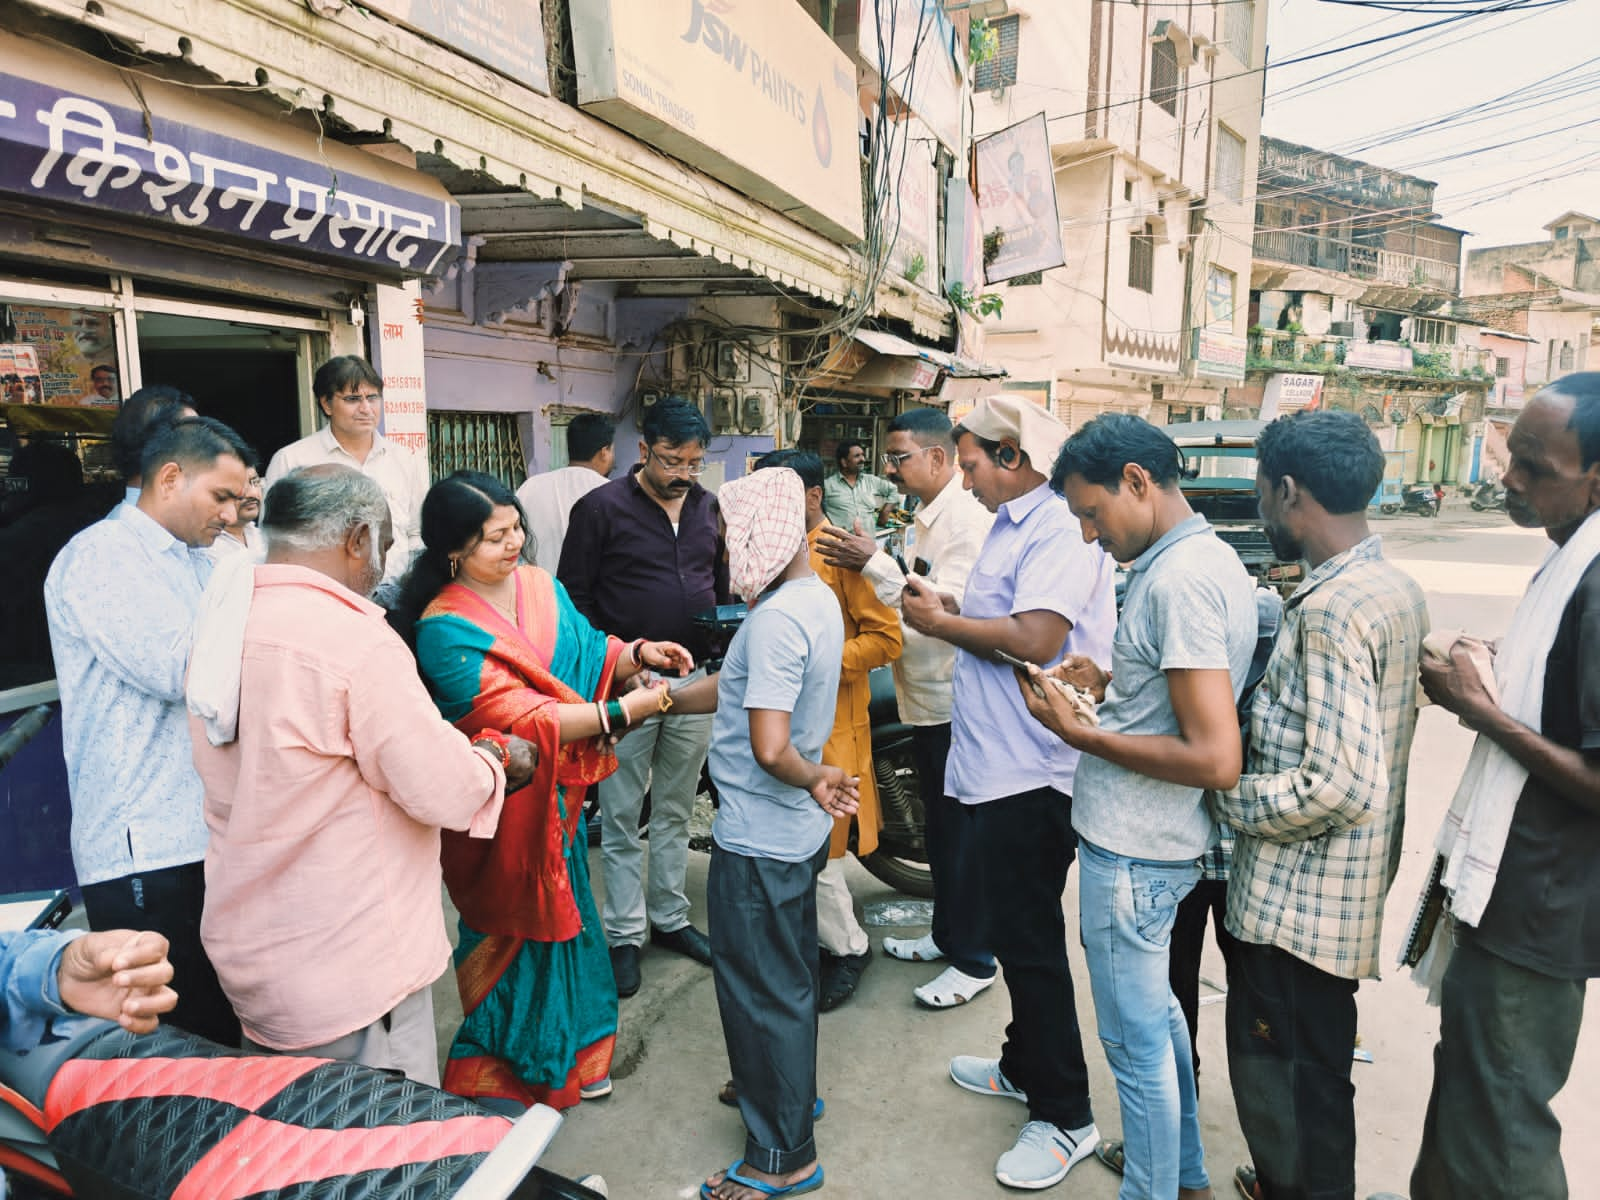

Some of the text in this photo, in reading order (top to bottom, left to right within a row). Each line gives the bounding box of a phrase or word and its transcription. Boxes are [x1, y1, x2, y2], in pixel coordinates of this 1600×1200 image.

[622, 69, 697, 130] SONAL TRADERS
[750, 48, 808, 126] PAINTS
[31, 96, 437, 268] किशुन प्रसाद
[1282, 376, 1314, 388] SAGAR
